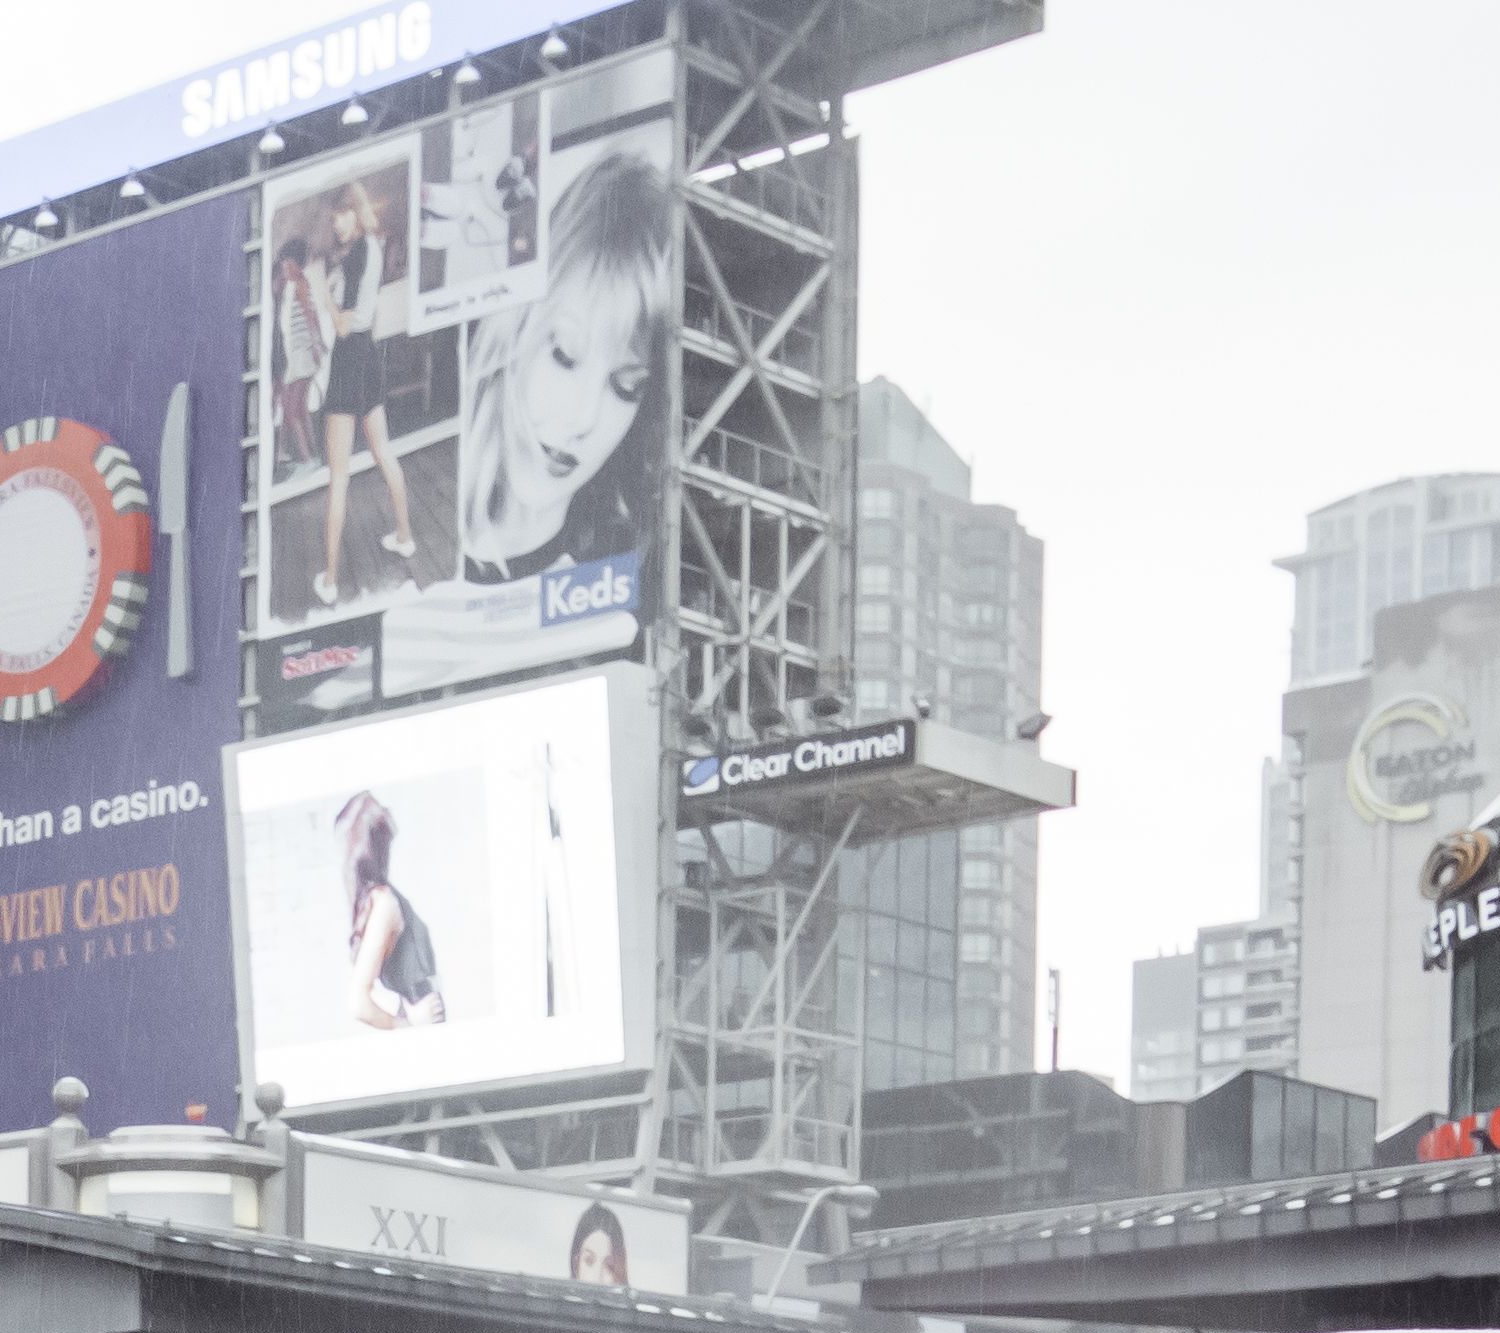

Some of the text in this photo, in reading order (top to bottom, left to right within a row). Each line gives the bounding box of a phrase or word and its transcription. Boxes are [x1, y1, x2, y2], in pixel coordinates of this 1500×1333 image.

[182, 1, 431, 137] SAMSUNG
[546, 565, 631, 619] Keds
[722, 725, 905, 786] Clear Channel
[60, 804, 83, 835] a
[89, 779, 208, 829] casino.
[73, 863, 181, 931] CASINO
[84, 926, 179, 965] FALLS
[369, 1205, 448, 1257] XXI
